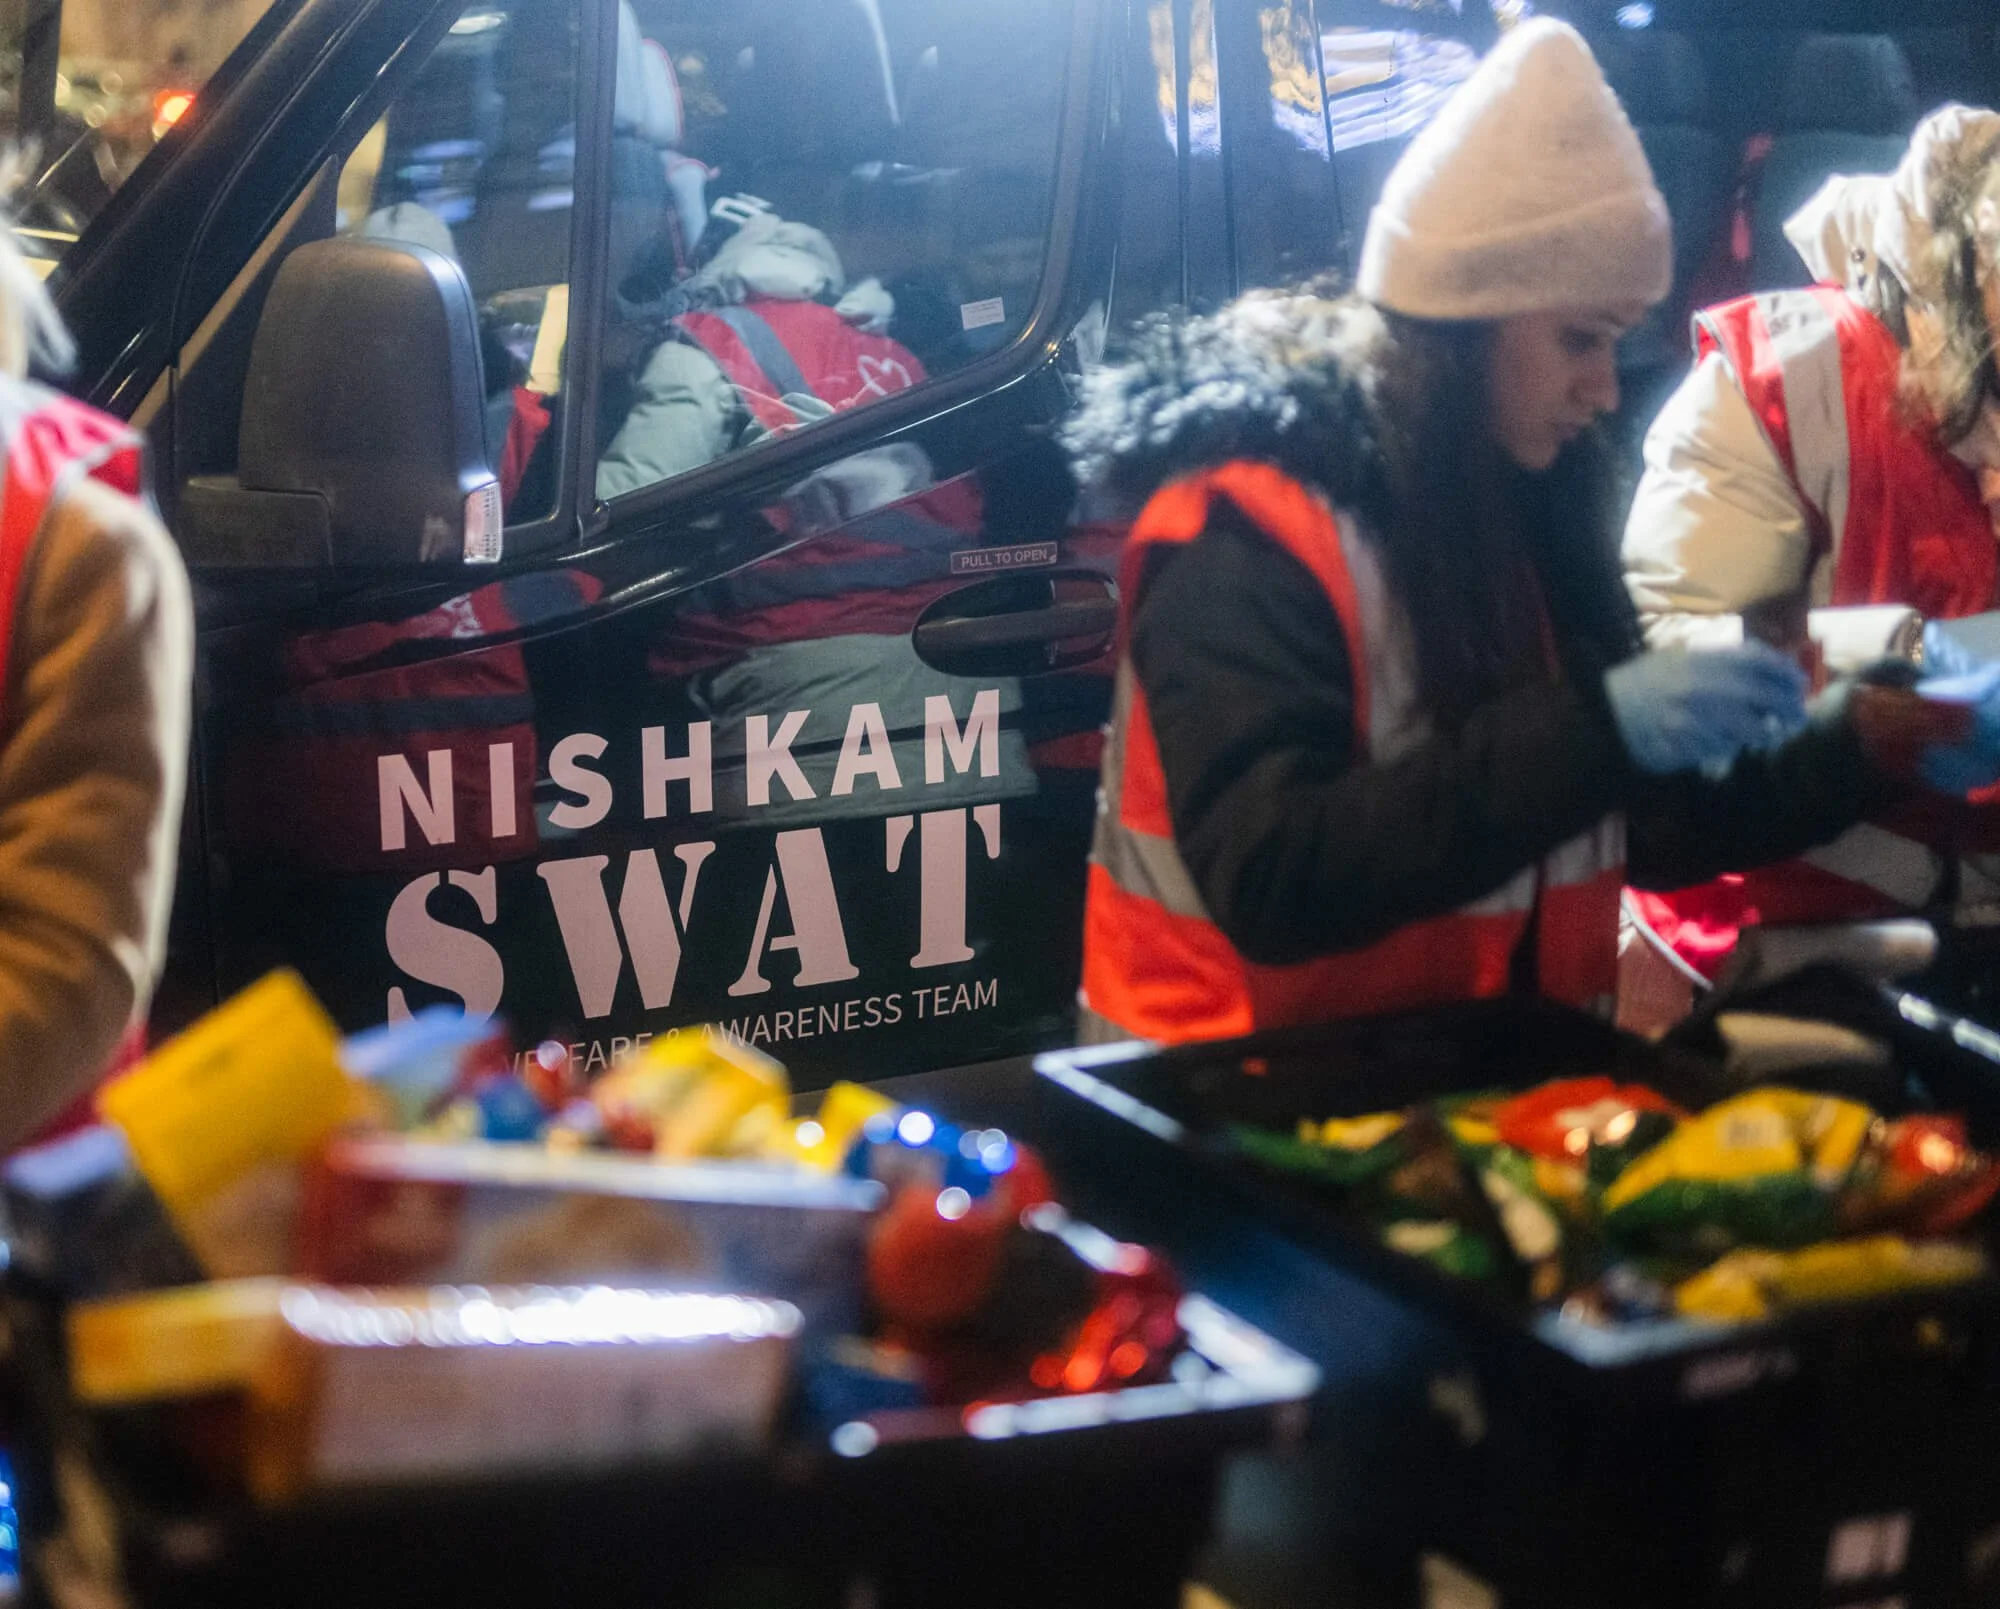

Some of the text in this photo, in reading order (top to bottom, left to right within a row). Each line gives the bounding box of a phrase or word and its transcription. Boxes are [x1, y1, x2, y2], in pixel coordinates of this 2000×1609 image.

[961, 549, 1048, 568] PULL TO OPEN
[377, 689, 1000, 852] NISHKAM
[385, 803, 1001, 1032] SWAT
[911, 978, 998, 1020] TEAM
